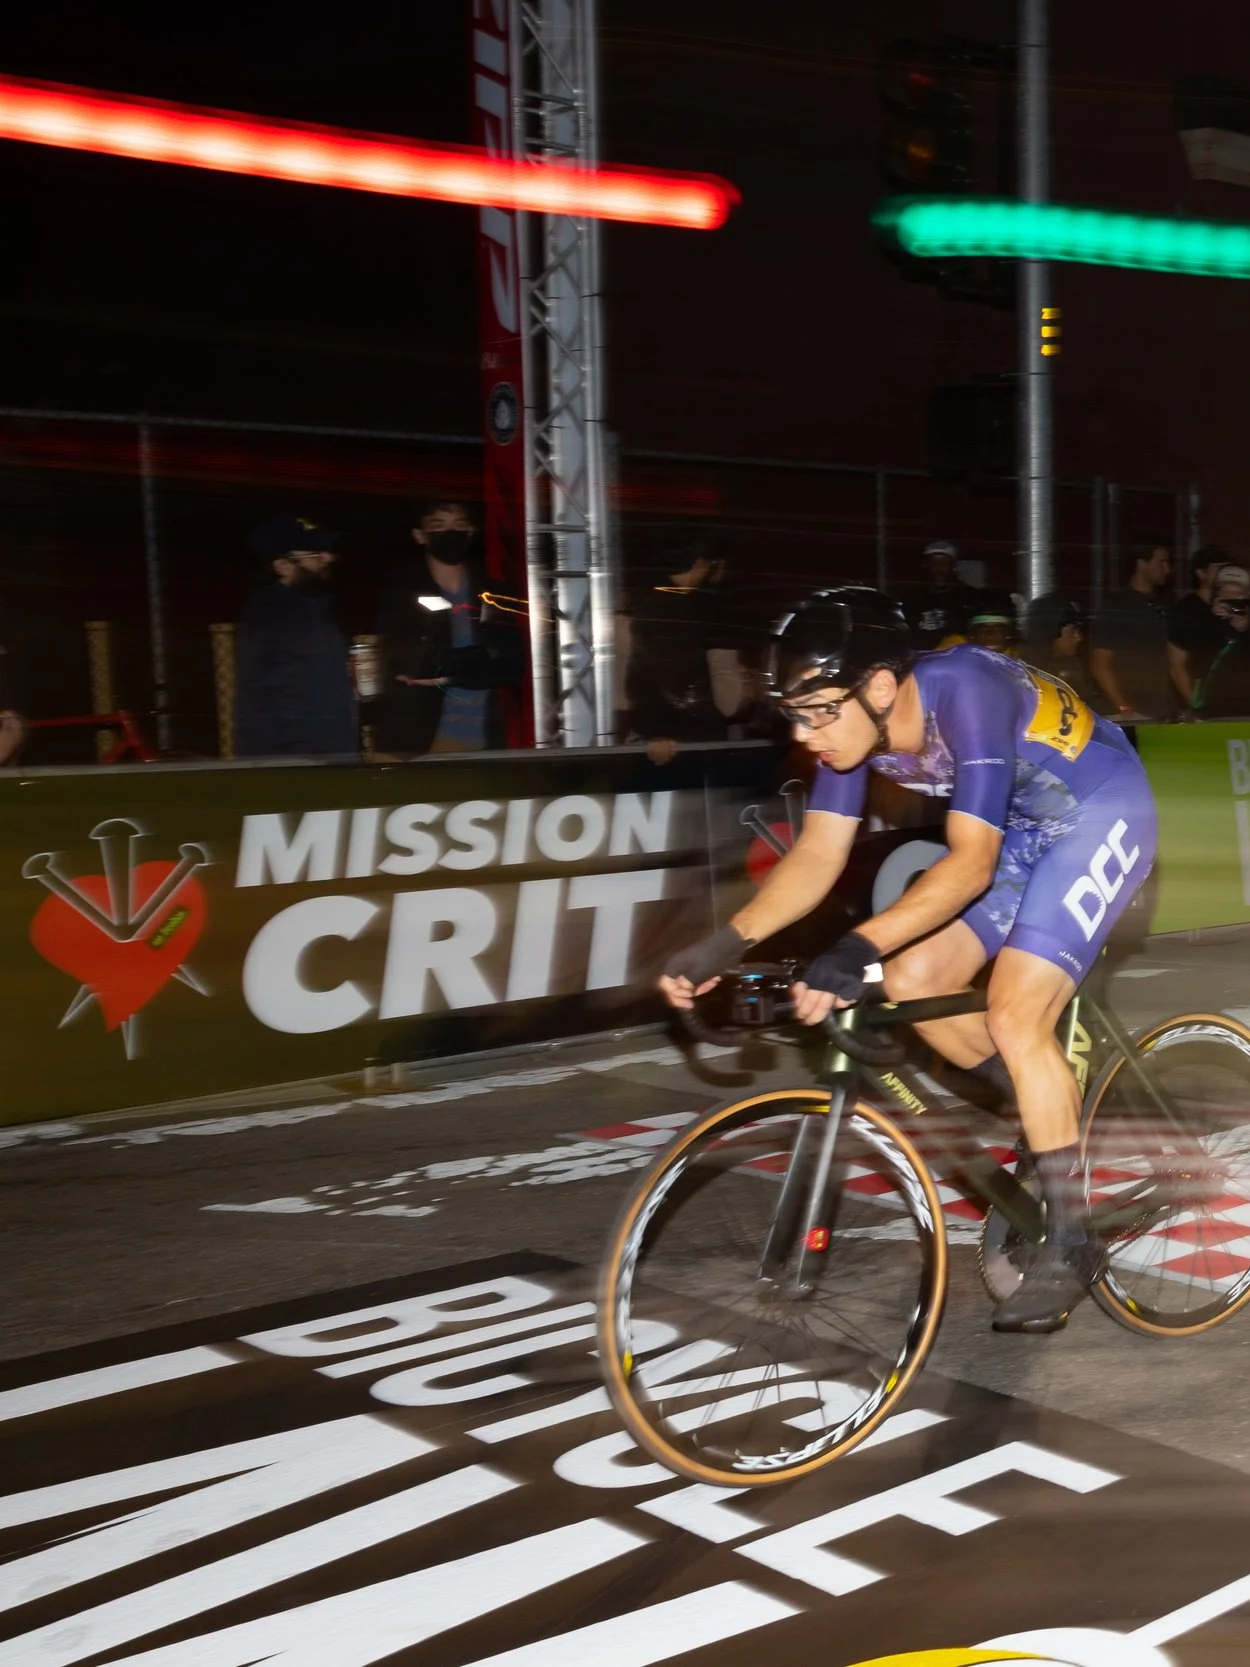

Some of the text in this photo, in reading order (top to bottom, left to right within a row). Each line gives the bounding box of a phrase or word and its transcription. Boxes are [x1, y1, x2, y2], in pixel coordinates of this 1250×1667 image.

[235, 790, 679, 888] MISSION
[1062, 818, 1140, 943] DCC
[242, 869, 668, 1035] CRIT
[879, 1071, 928, 1115] AFFINITY
